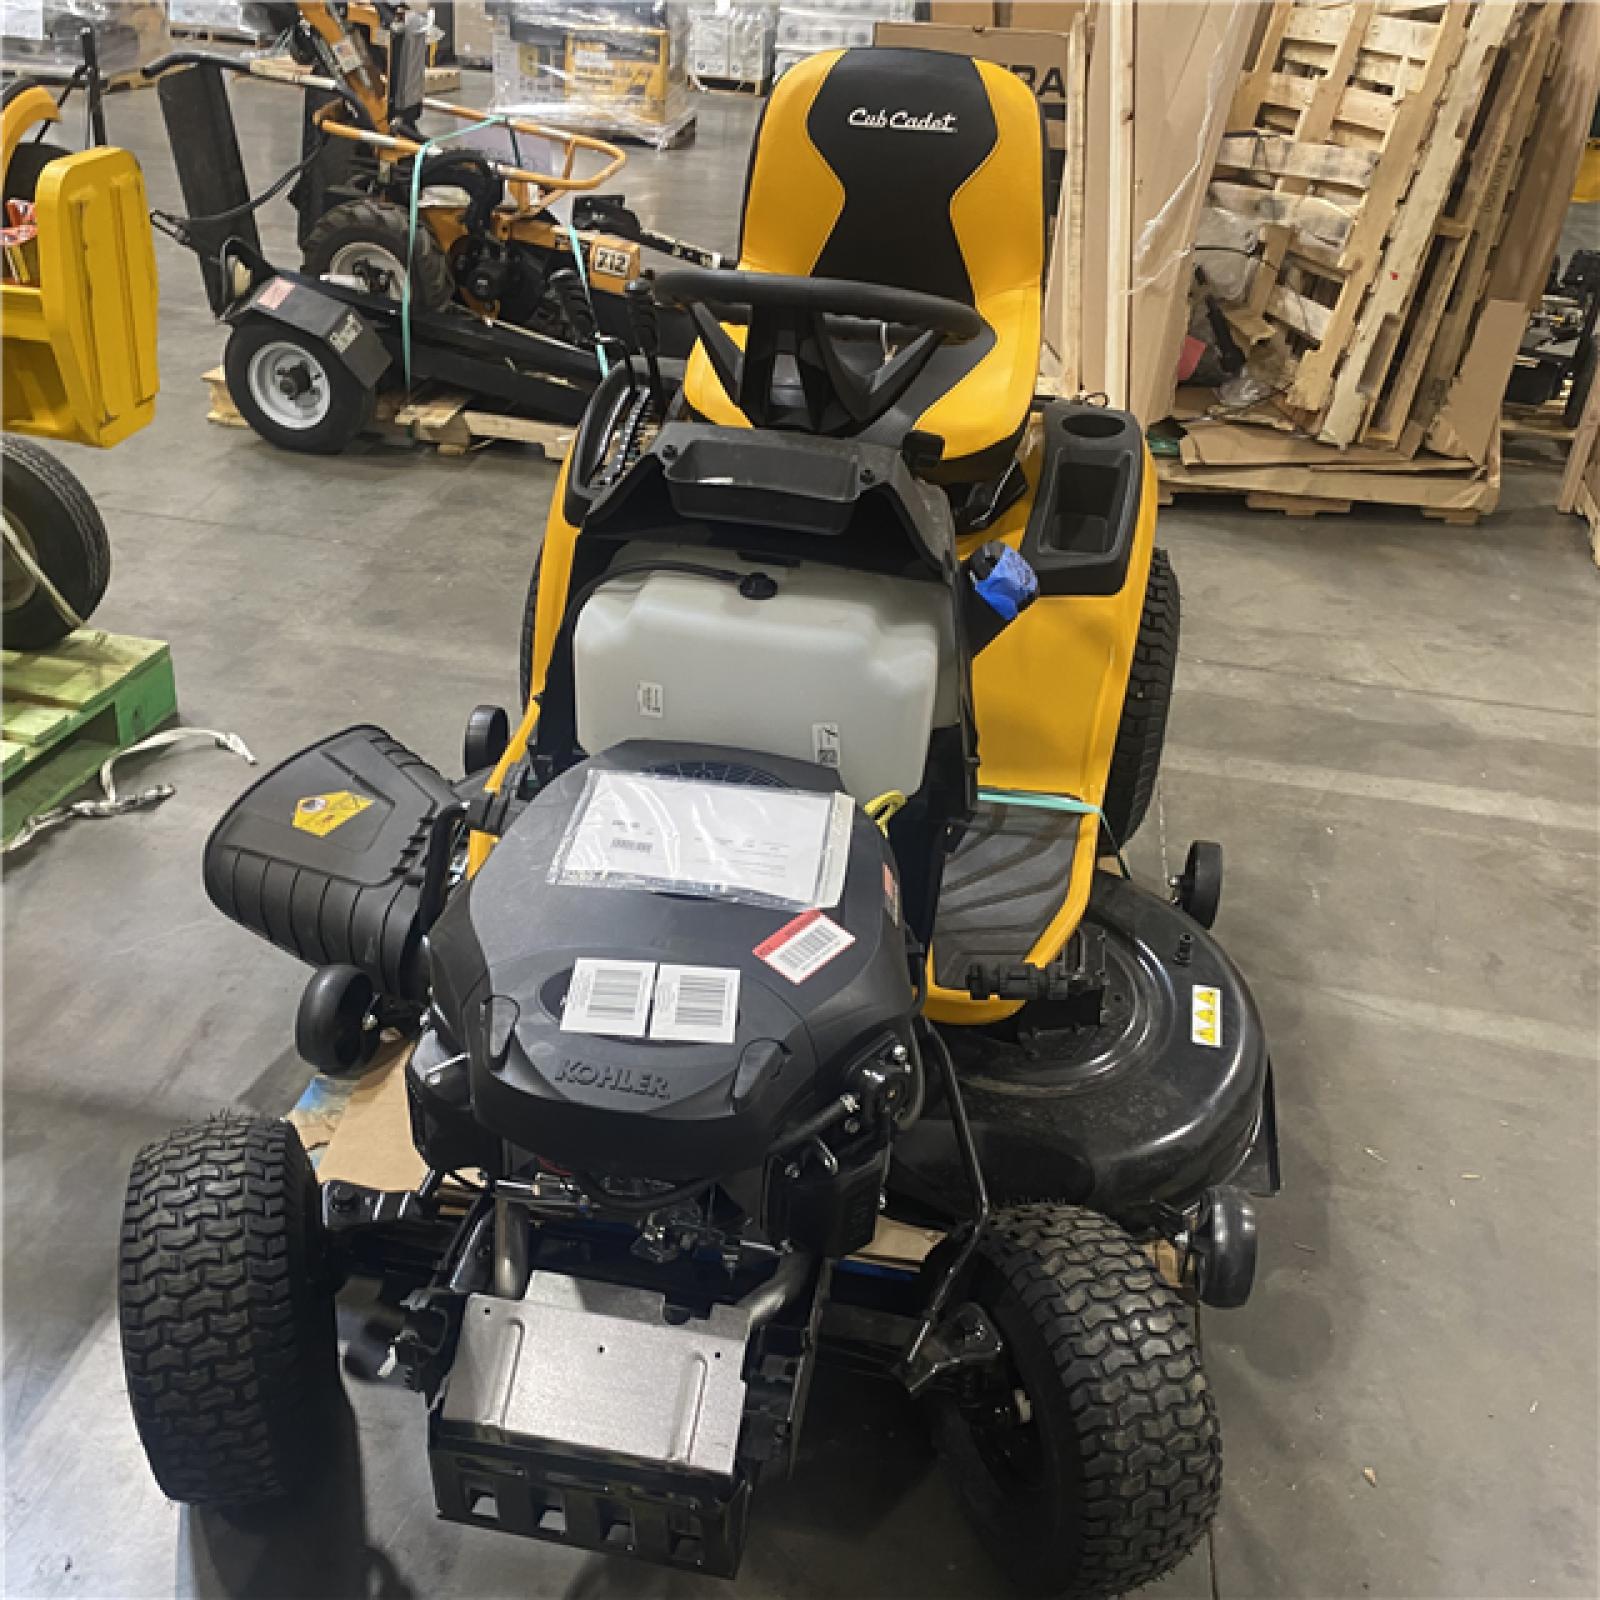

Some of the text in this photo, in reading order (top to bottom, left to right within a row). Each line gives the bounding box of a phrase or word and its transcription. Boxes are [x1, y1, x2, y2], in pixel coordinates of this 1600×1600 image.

[848, 107, 958, 133] Cub Cadet
[555, 1060, 671, 1099] KOHLER
